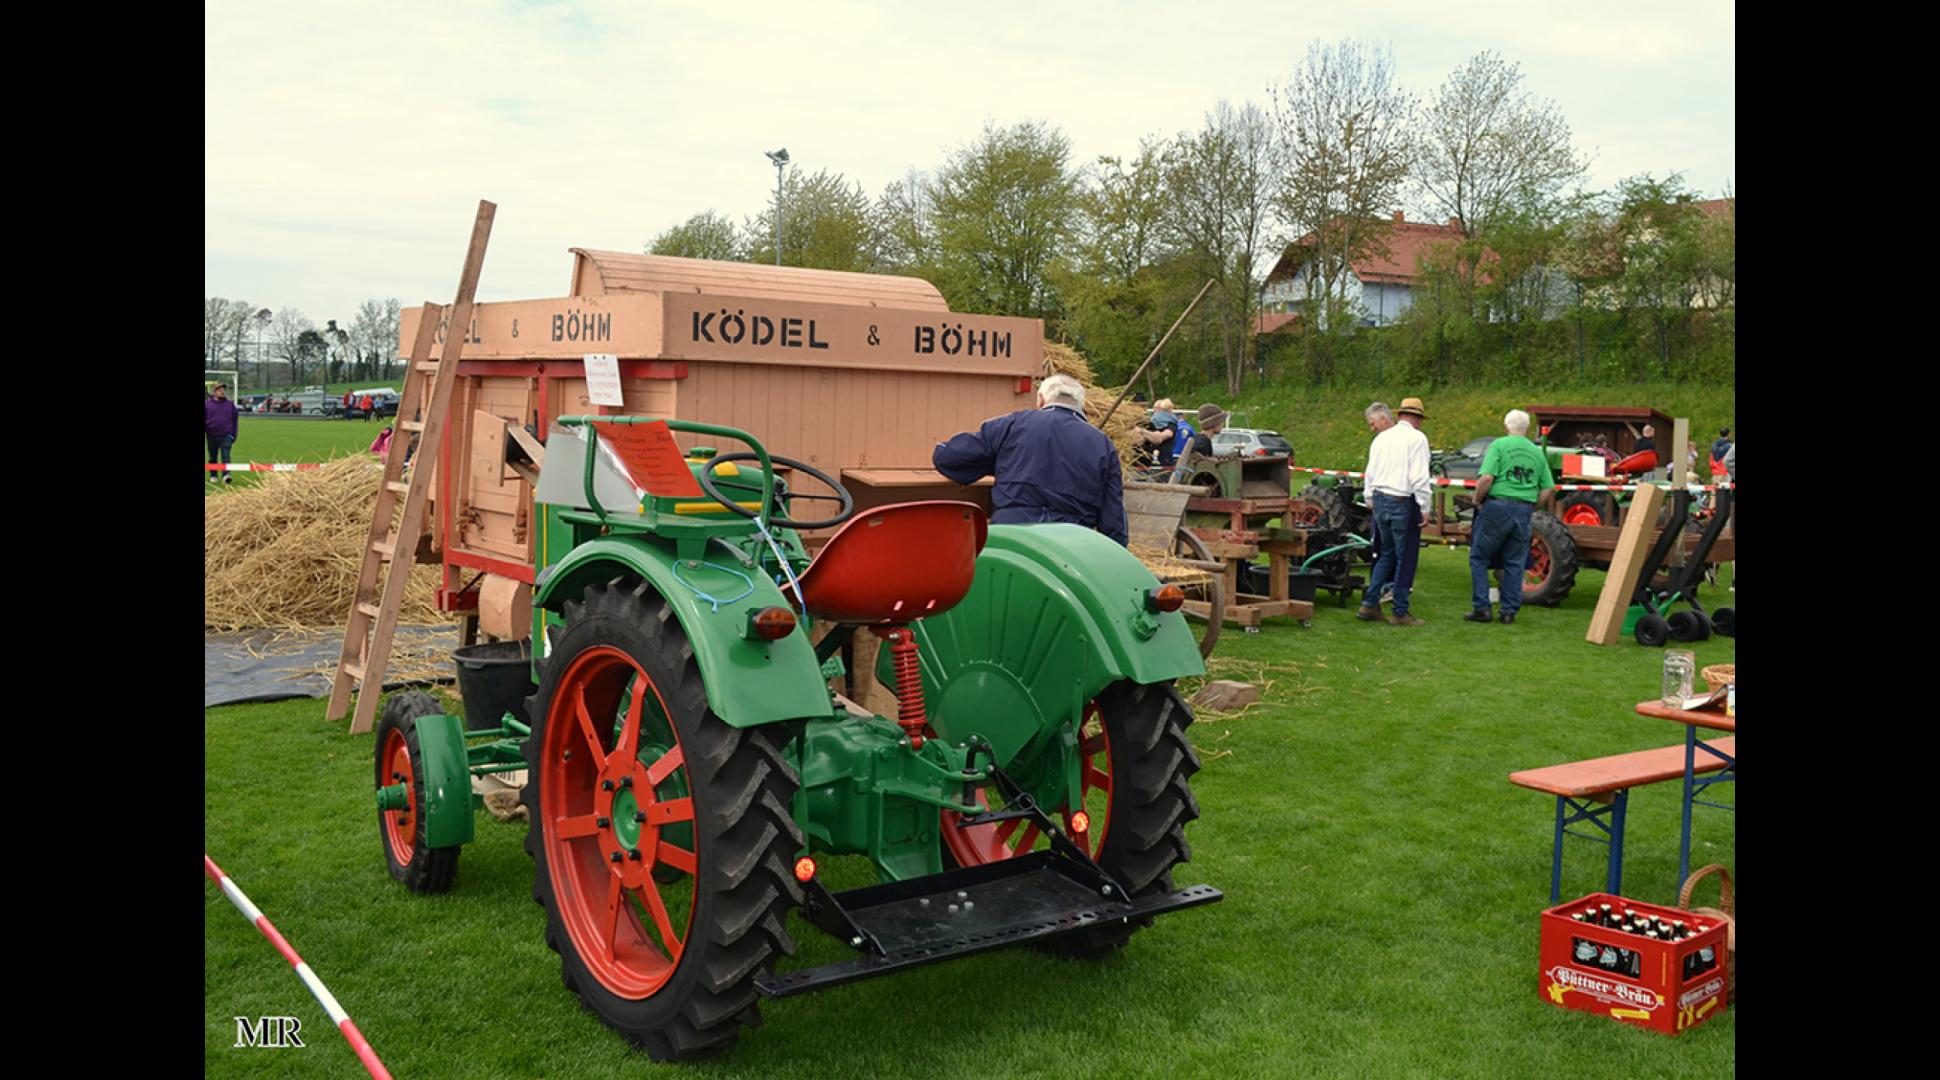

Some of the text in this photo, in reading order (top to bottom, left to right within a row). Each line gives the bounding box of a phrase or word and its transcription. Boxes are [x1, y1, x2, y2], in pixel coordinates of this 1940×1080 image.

[511, 318, 519, 338] &
[551, 308, 611, 342] BÖHM
[692, 308, 1012, 358] KÖDEL & BÖHM
